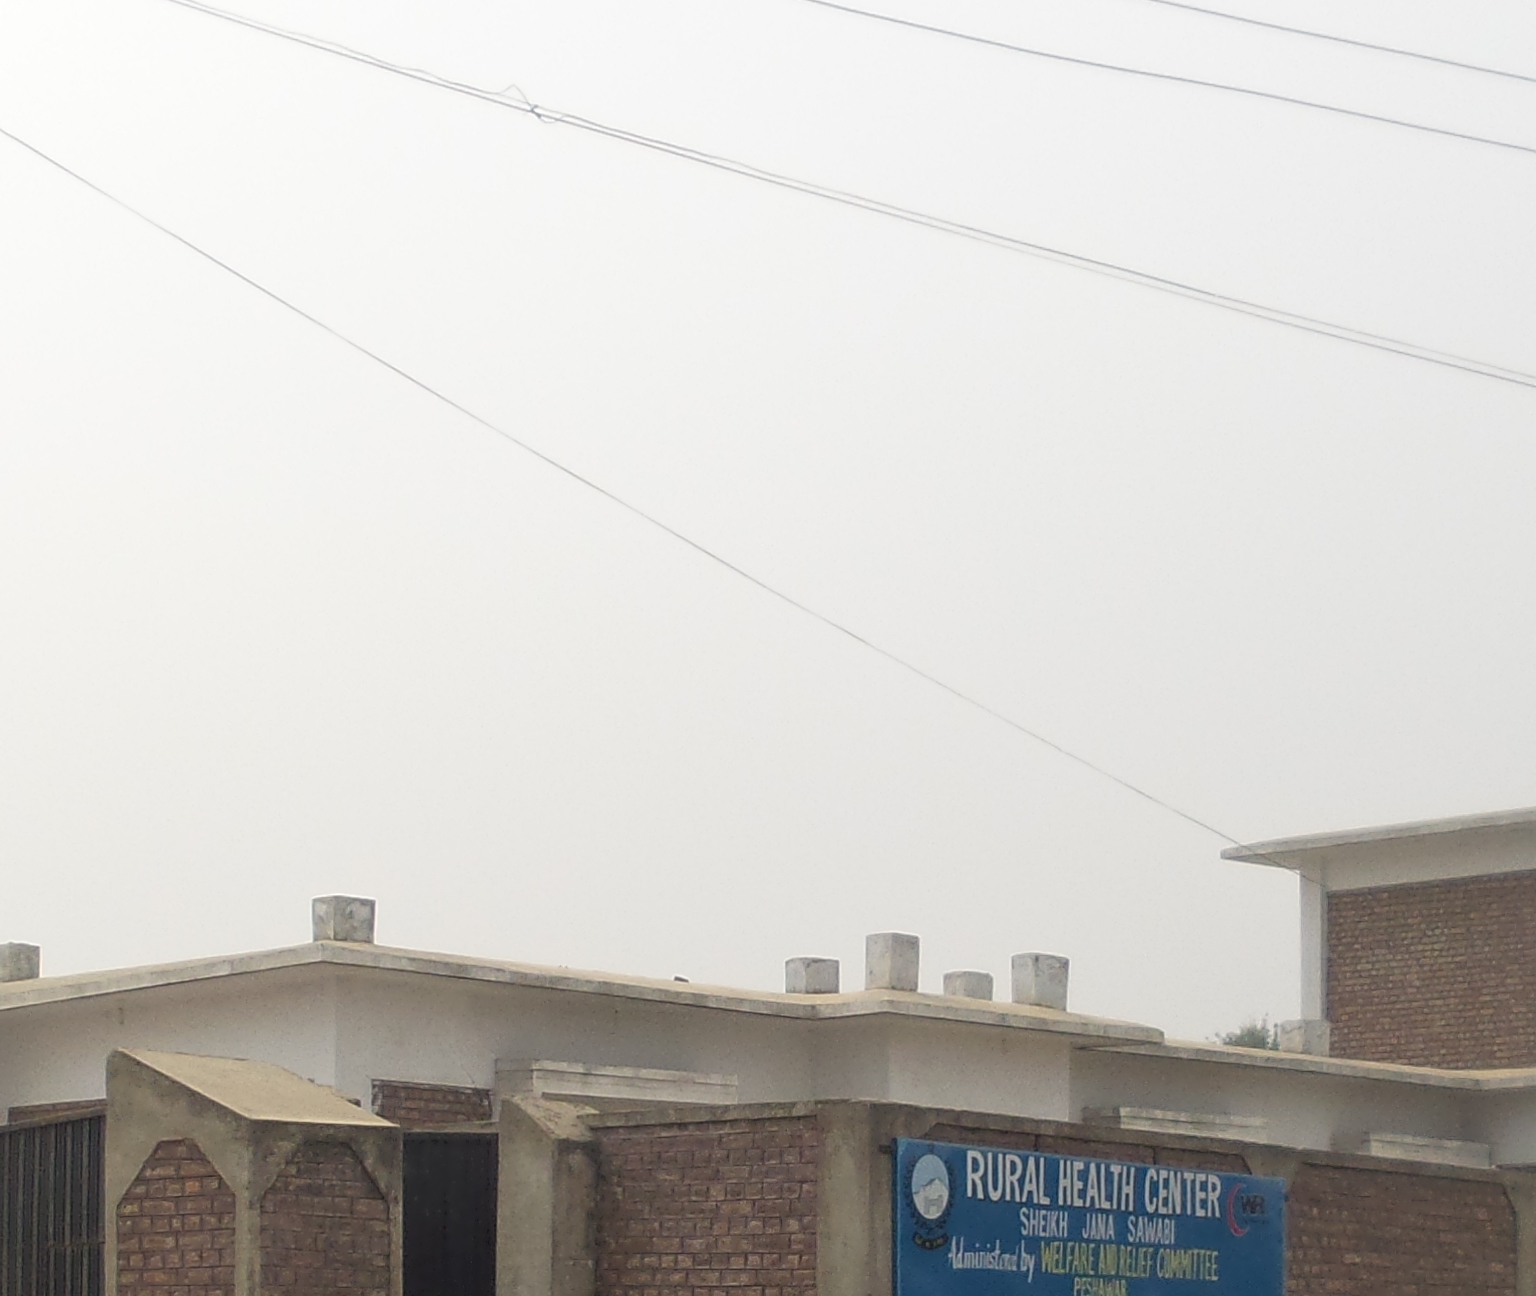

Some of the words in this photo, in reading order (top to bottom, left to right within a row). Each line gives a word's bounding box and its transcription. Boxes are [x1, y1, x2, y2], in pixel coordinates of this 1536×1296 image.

[966, 1150, 1051, 1205] RURAL
[1058, 1158, 1136, 1212] HEALTH
[1144, 1168, 1222, 1218] CENTER
[1019, 1207, 1068, 1238] SHEIKH
[1082, 1213, 1115, 1240] JANA
[1127, 1215, 1175, 1244] SAWABI
[1020, 1239, 1035, 1283] by
[1041, 1241, 1095, 1275] WELFARE
[1098, 1243, 1117, 1276] AND
[1119, 1245, 1154, 1278] RELIEF
[1157, 1248, 1219, 1281] COMMITTEE
